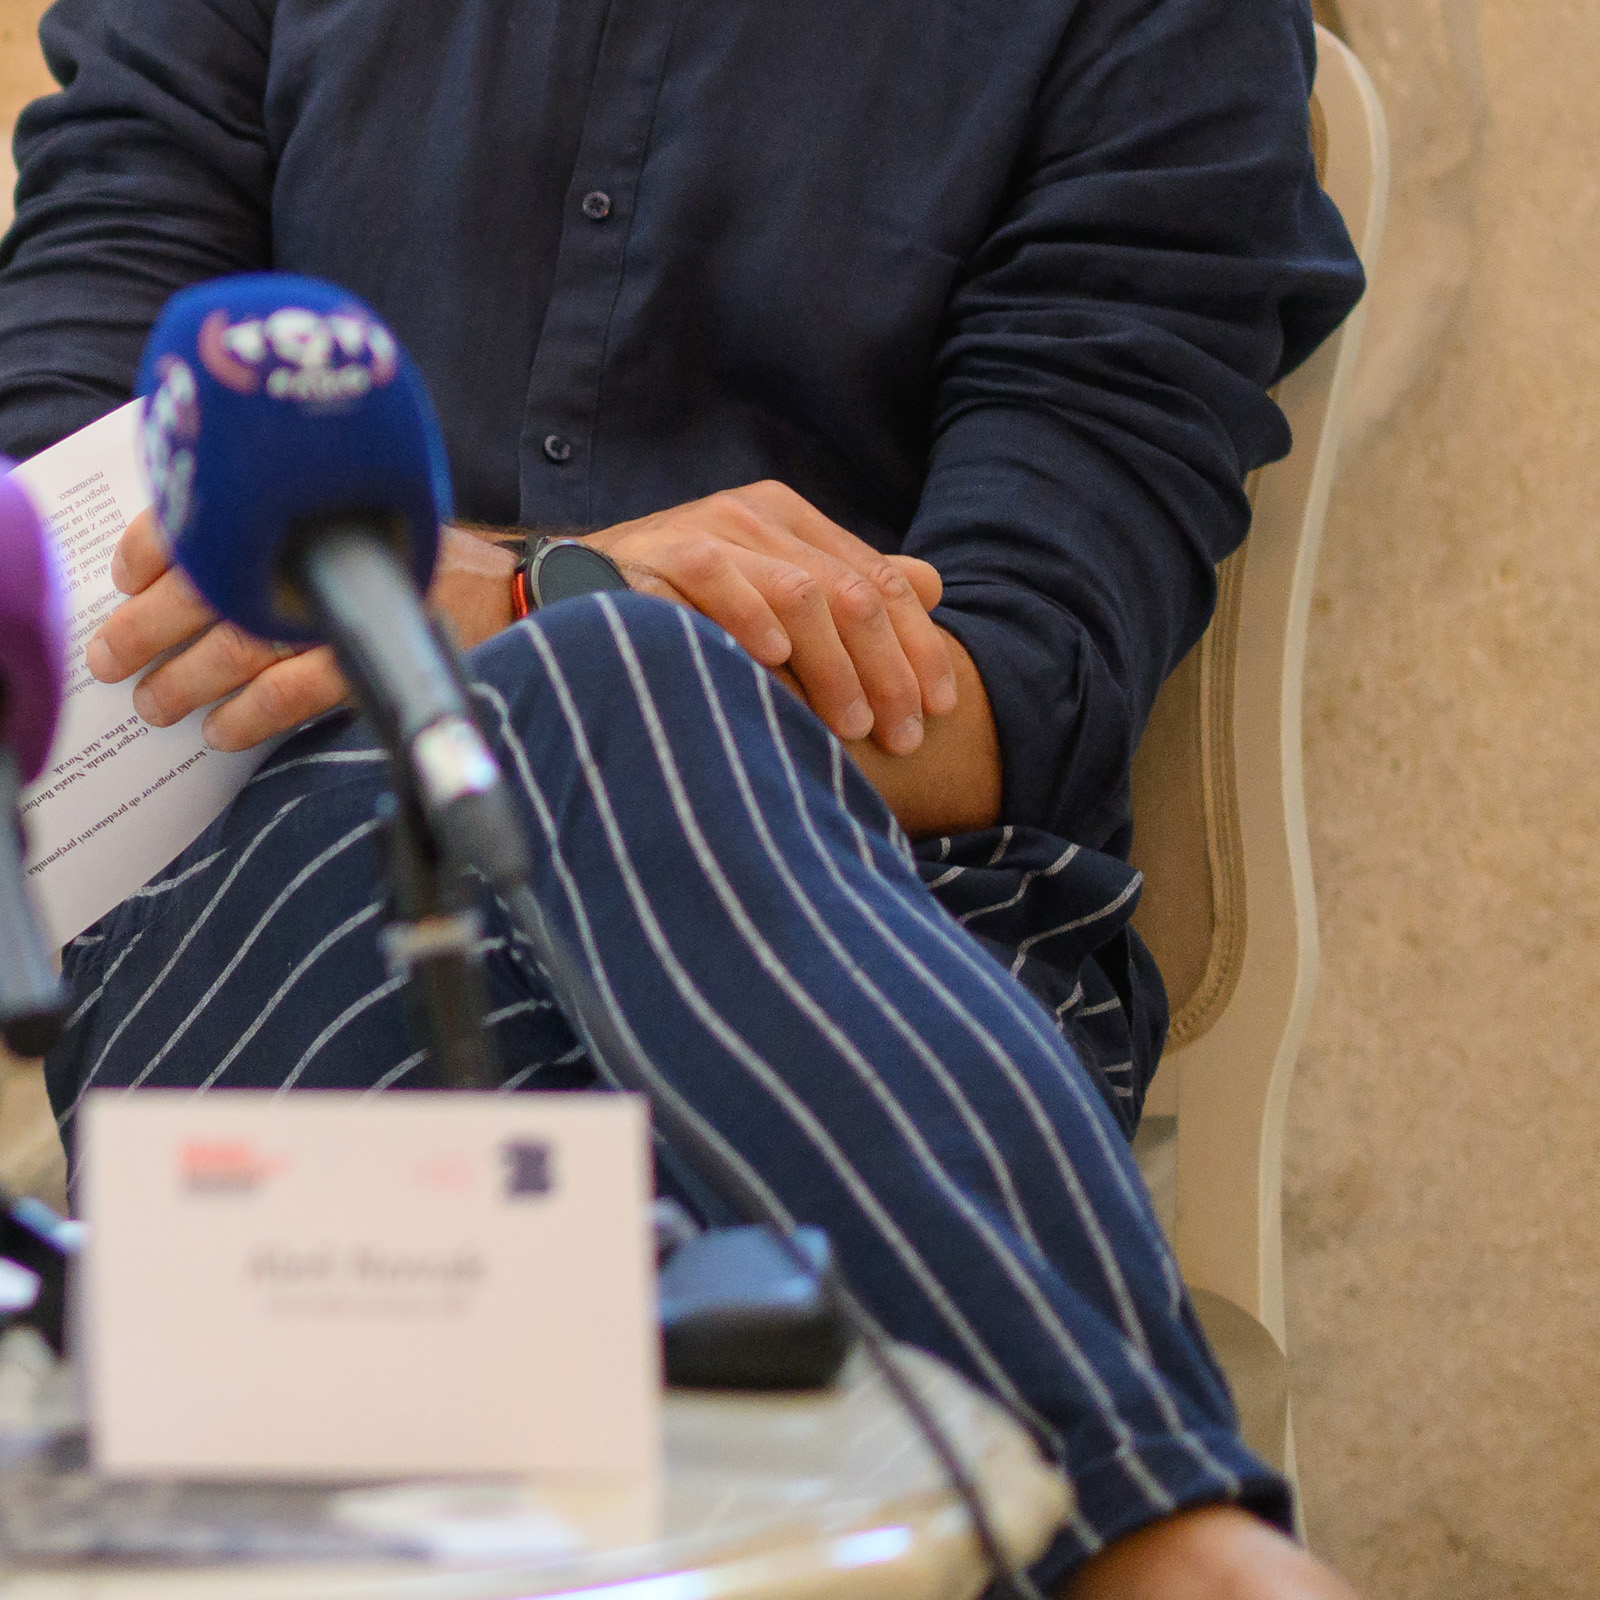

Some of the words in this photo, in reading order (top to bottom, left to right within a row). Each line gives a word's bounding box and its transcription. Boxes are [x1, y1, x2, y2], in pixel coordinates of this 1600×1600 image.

[72, 481, 111, 509] njegove
[83, 494, 117, 520] temelji
[40, 504, 75, 529] kreacij
[70, 514, 84, 526] na
[89, 522, 97, 530] z
[97, 508, 123, 528] likov
[53, 526, 91, 553] navidez
[75, 519, 129, 555] povezanost
[77, 541, 118, 570] utljivosti
[66, 566, 78, 576] za
[80, 571, 93, 584] je
[91, 563, 110, 579] alič
[77, 609, 88, 620] in
[100, 721, 127, 744] Brea,
[125, 713, 139, 727] de
[81, 738, 103, 758] Aleš
[113, 722, 149, 752] Gregor
[51, 751, 83, 777] Novak
[82, 746, 117, 774] Butala,
[175, 748, 206, 775] kratki
[52, 768, 85, 794] Nataša
[139, 768, 177, 798] pogovor
[19, 788, 54, 817] Barbar
[127, 795, 142, 809] ob
[75, 802, 129, 845] predstavitvi
[25, 837, 78, 879] prejemnika
